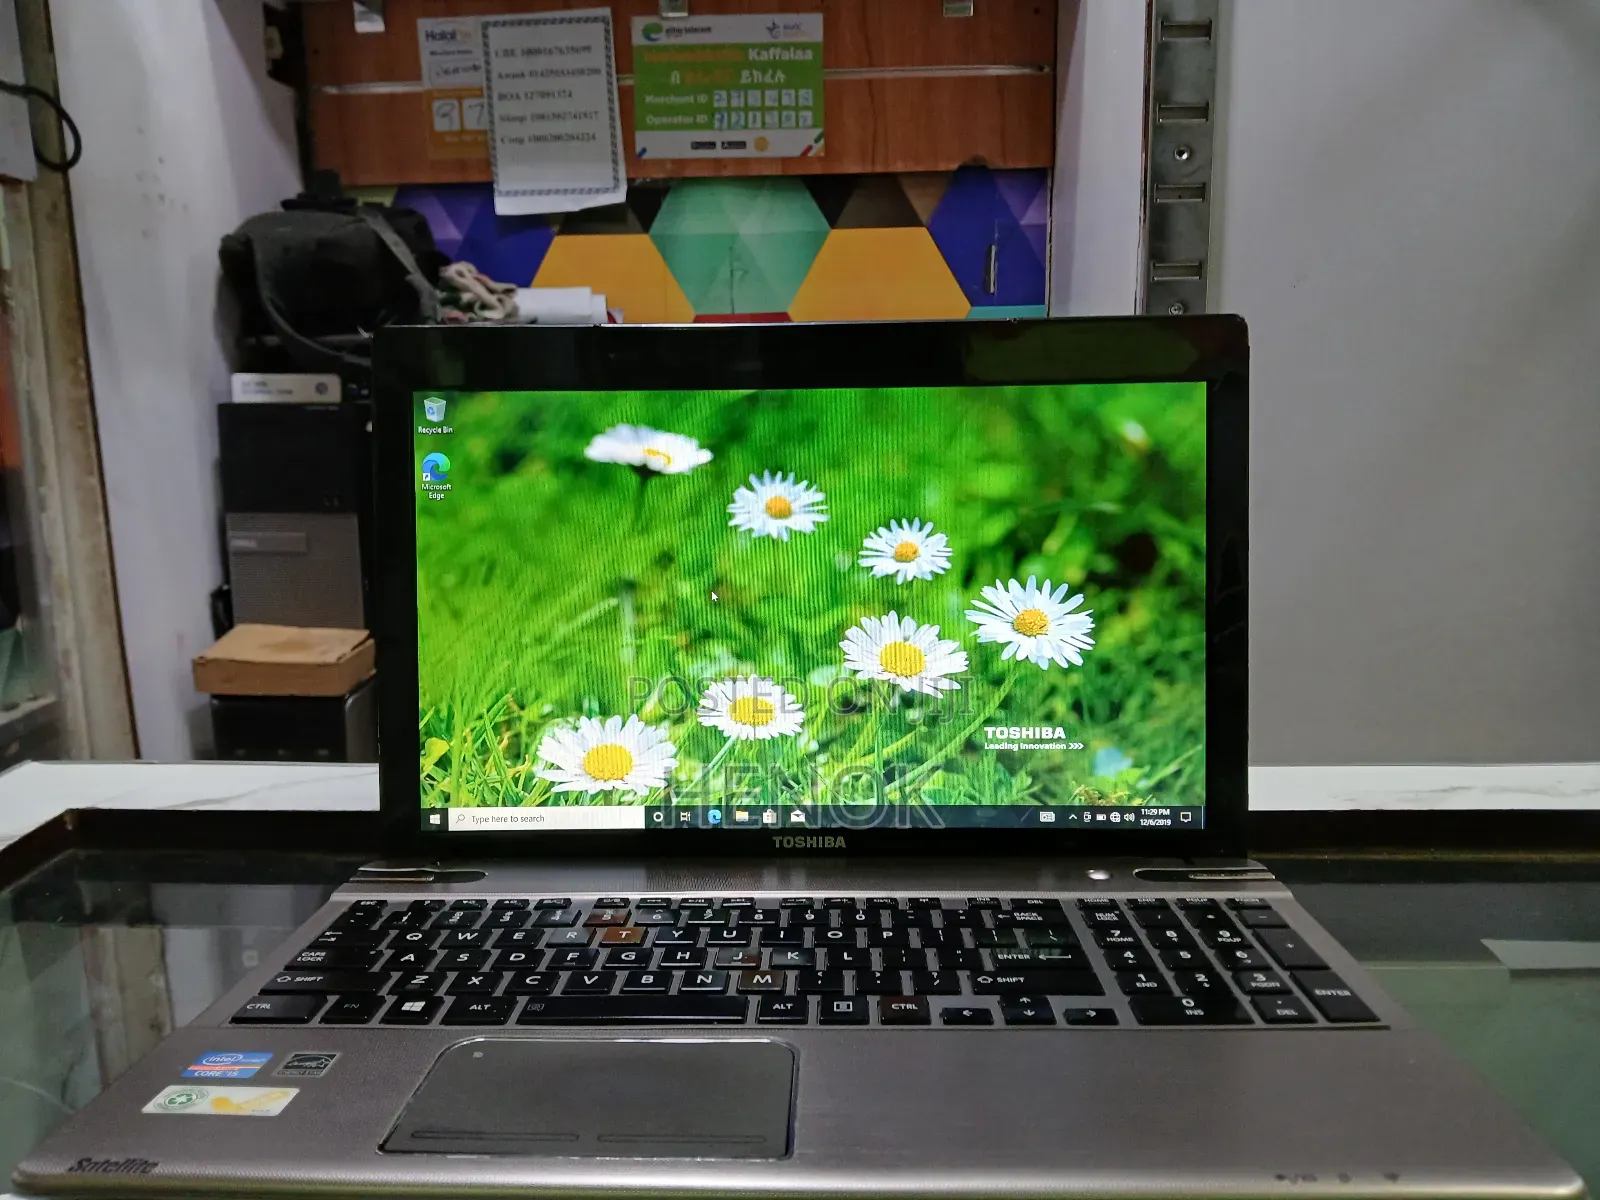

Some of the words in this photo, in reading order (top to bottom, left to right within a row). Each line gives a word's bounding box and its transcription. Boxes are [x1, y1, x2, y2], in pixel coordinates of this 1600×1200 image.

[418, 426, 441, 435] Recycle
[429, 492, 445, 500] Edge
[985, 727, 1066, 740] TOSHIBA
[985, 741, 1018, 752] Leading
[1020, 741, 1067, 750] Innovation
[472, 814, 489, 824] Type
[491, 814, 507, 823] here
[510, 814, 518, 823] to
[520, 814, 545, 823] search
[772, 836, 847, 849] TOSHIBA
[621, 952, 636, 960] G
[844, 952, 852, 960] L
[526, 976, 541, 984] C
[584, 976, 598, 984] V
[641, 975, 653, 983] B
[697, 975, 712, 983] N
[753, 975, 771, 983] M
[207, 1054, 240, 1063] intel
[68, 1157, 160, 1173] Satellite
